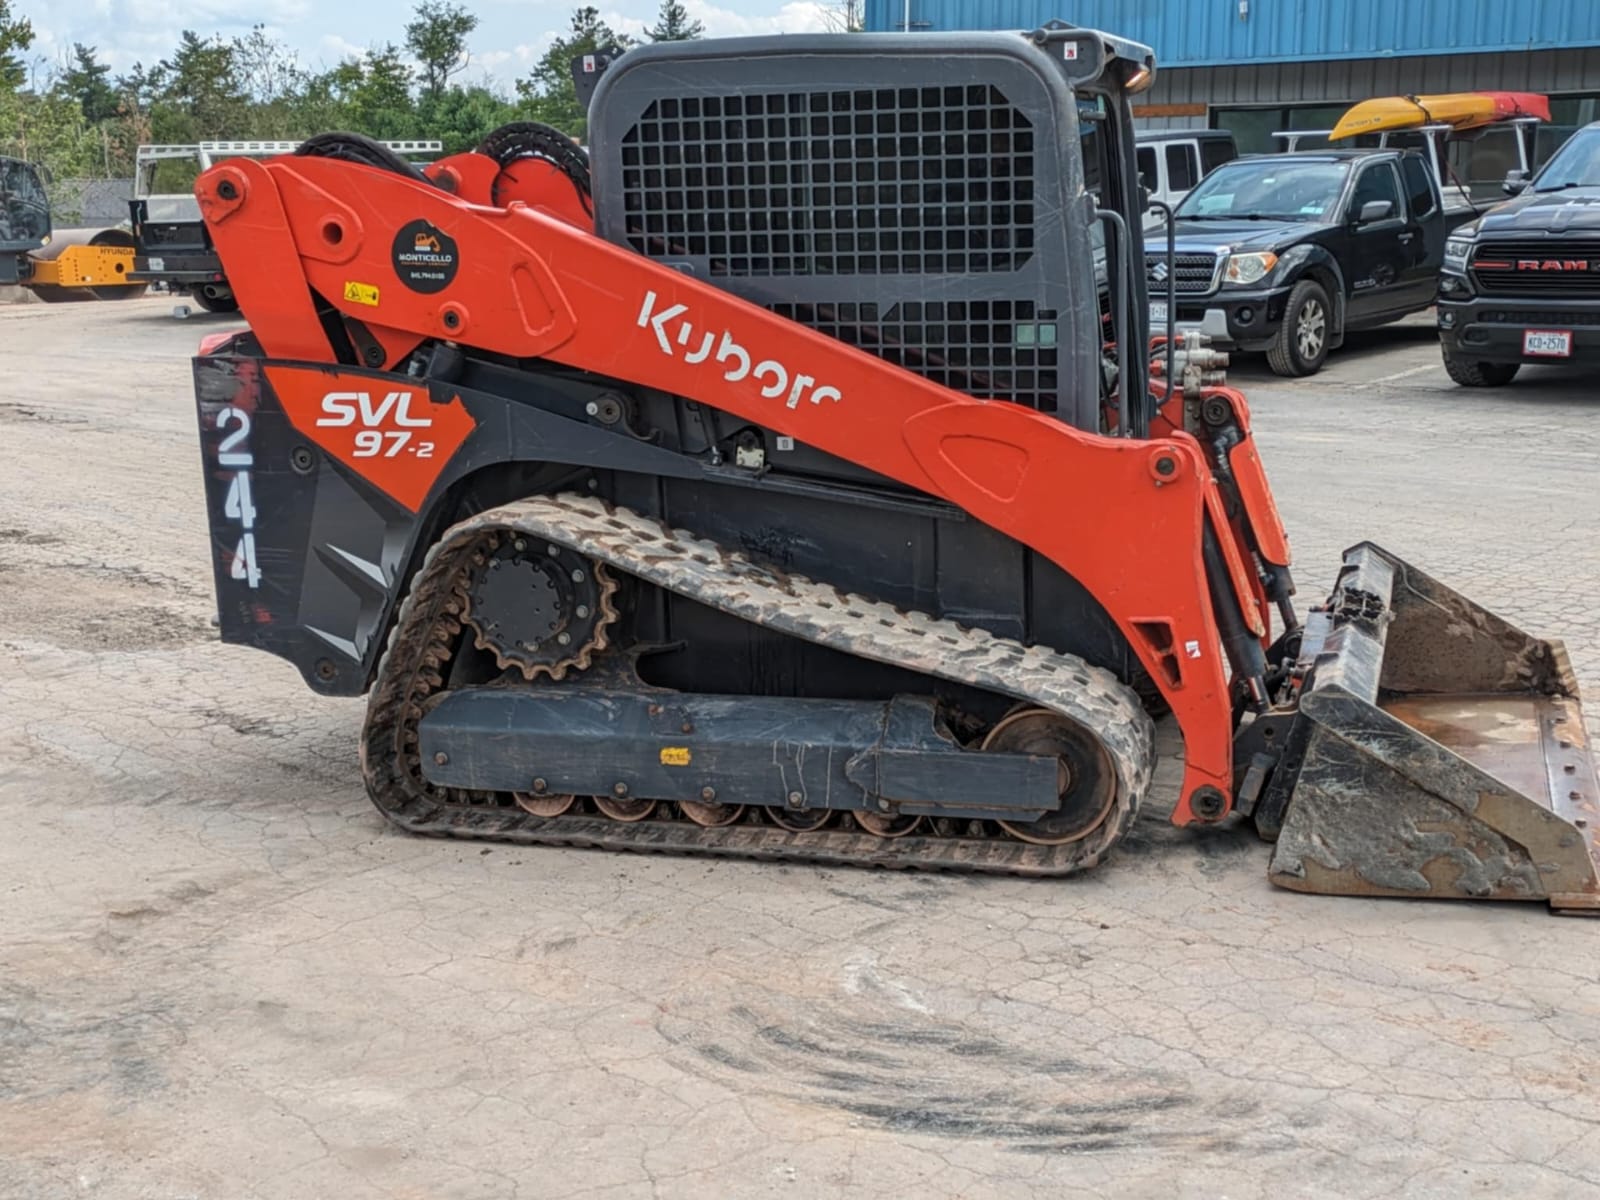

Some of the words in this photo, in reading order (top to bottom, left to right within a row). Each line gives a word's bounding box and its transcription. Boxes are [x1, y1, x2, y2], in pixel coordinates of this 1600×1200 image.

[100, 247, 135, 256] HYUNDA
[1518, 260, 1588, 270] RAM
[316, 392, 432, 426] SVL
[353, 431, 434, 457] 97-2
